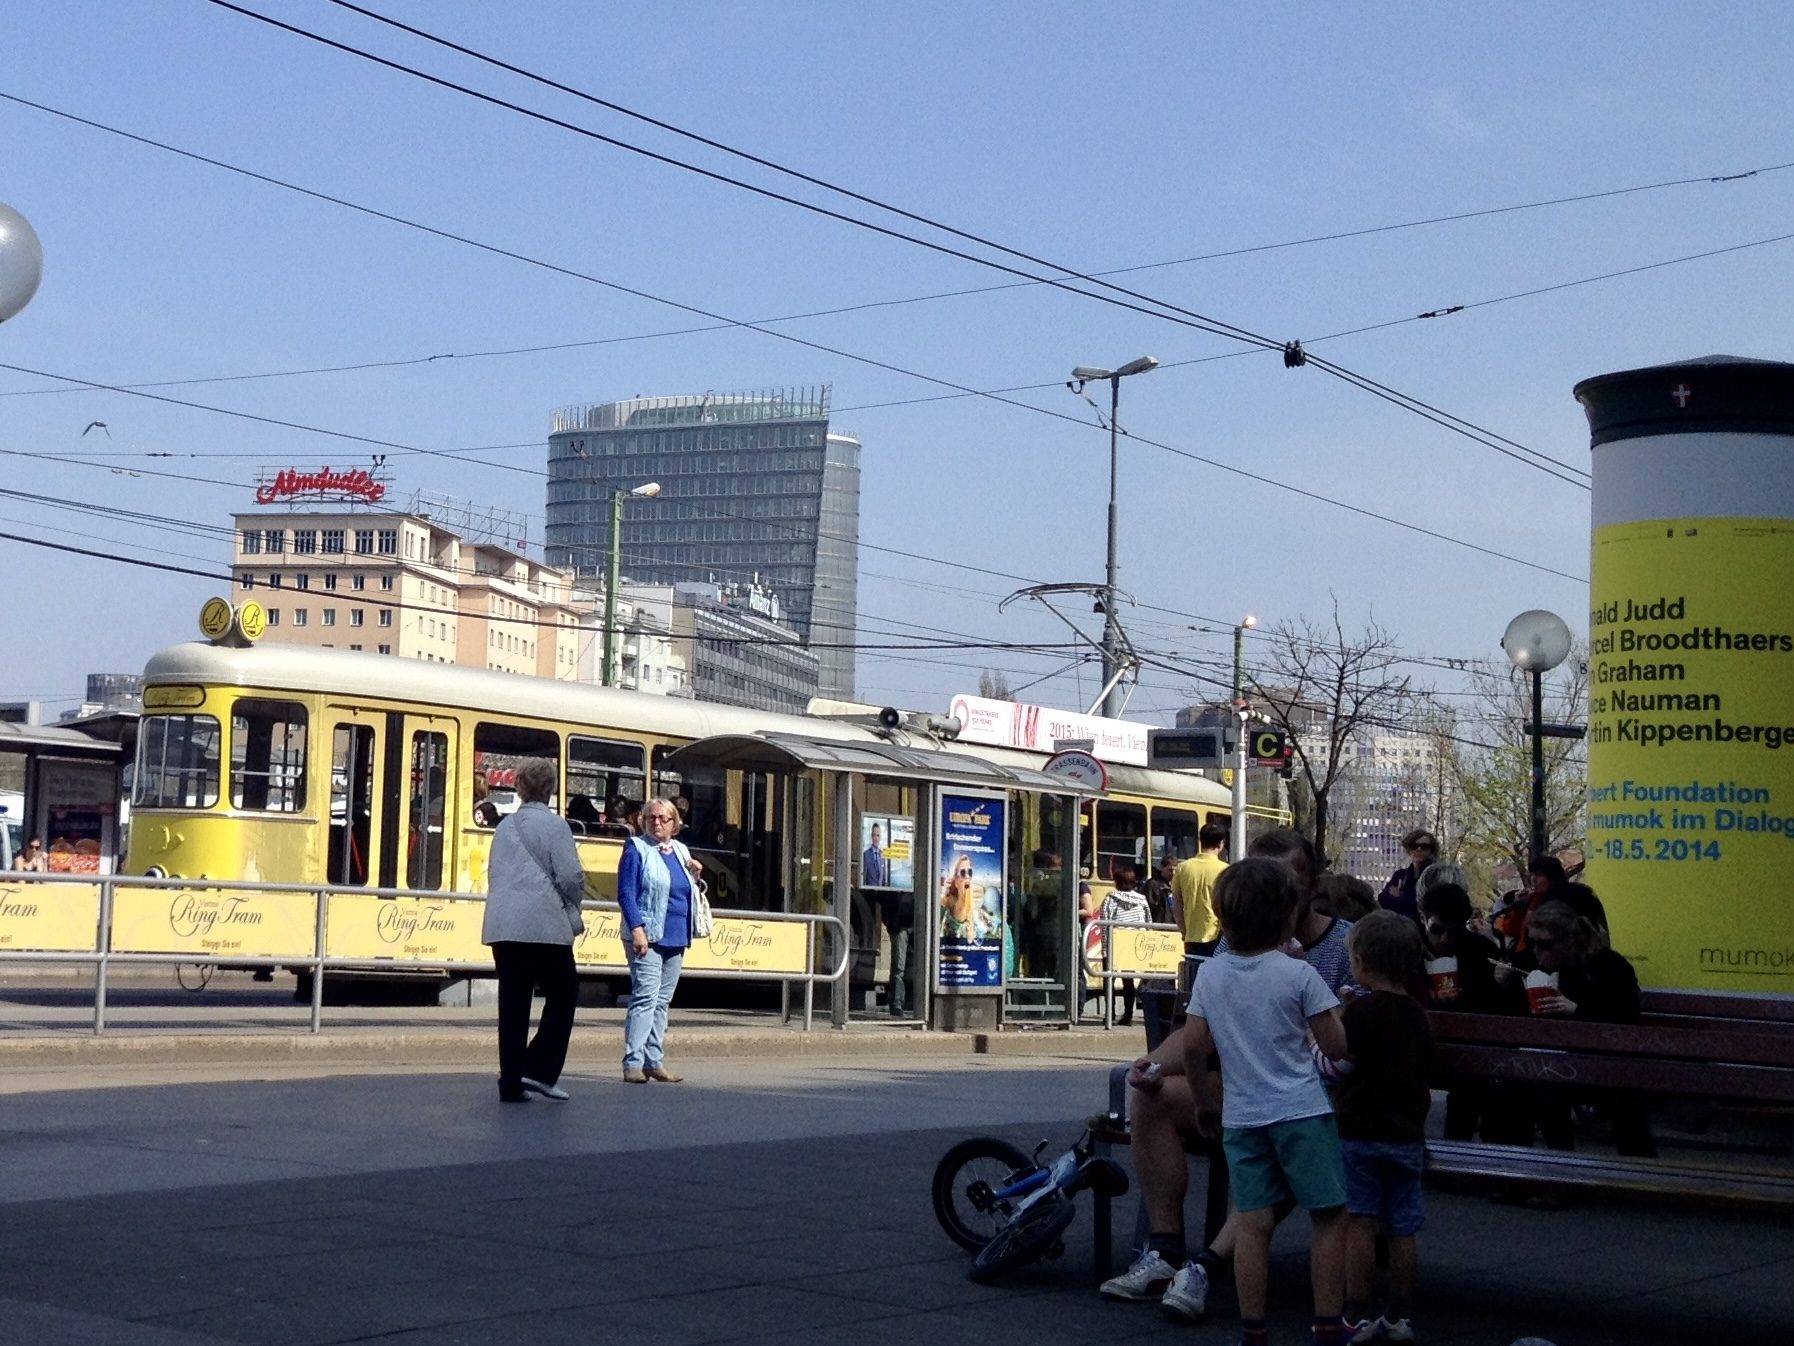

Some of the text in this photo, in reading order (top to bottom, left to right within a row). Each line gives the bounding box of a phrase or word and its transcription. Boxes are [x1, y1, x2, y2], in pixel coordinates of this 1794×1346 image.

[1623, 597, 1685, 622] Judd
[1620, 626, 1793, 652] Broodthaers
[1598, 659, 1685, 684] Graham
[1611, 689, 1721, 712] Nauman
[1256, 733, 1278, 758] C
[1622, 780, 1770, 804] Foundation
[1672, 808, 1706, 831] im
[169, 894, 262, 938] Ring Tram
[377, 903, 455, 943] Ring Tram
